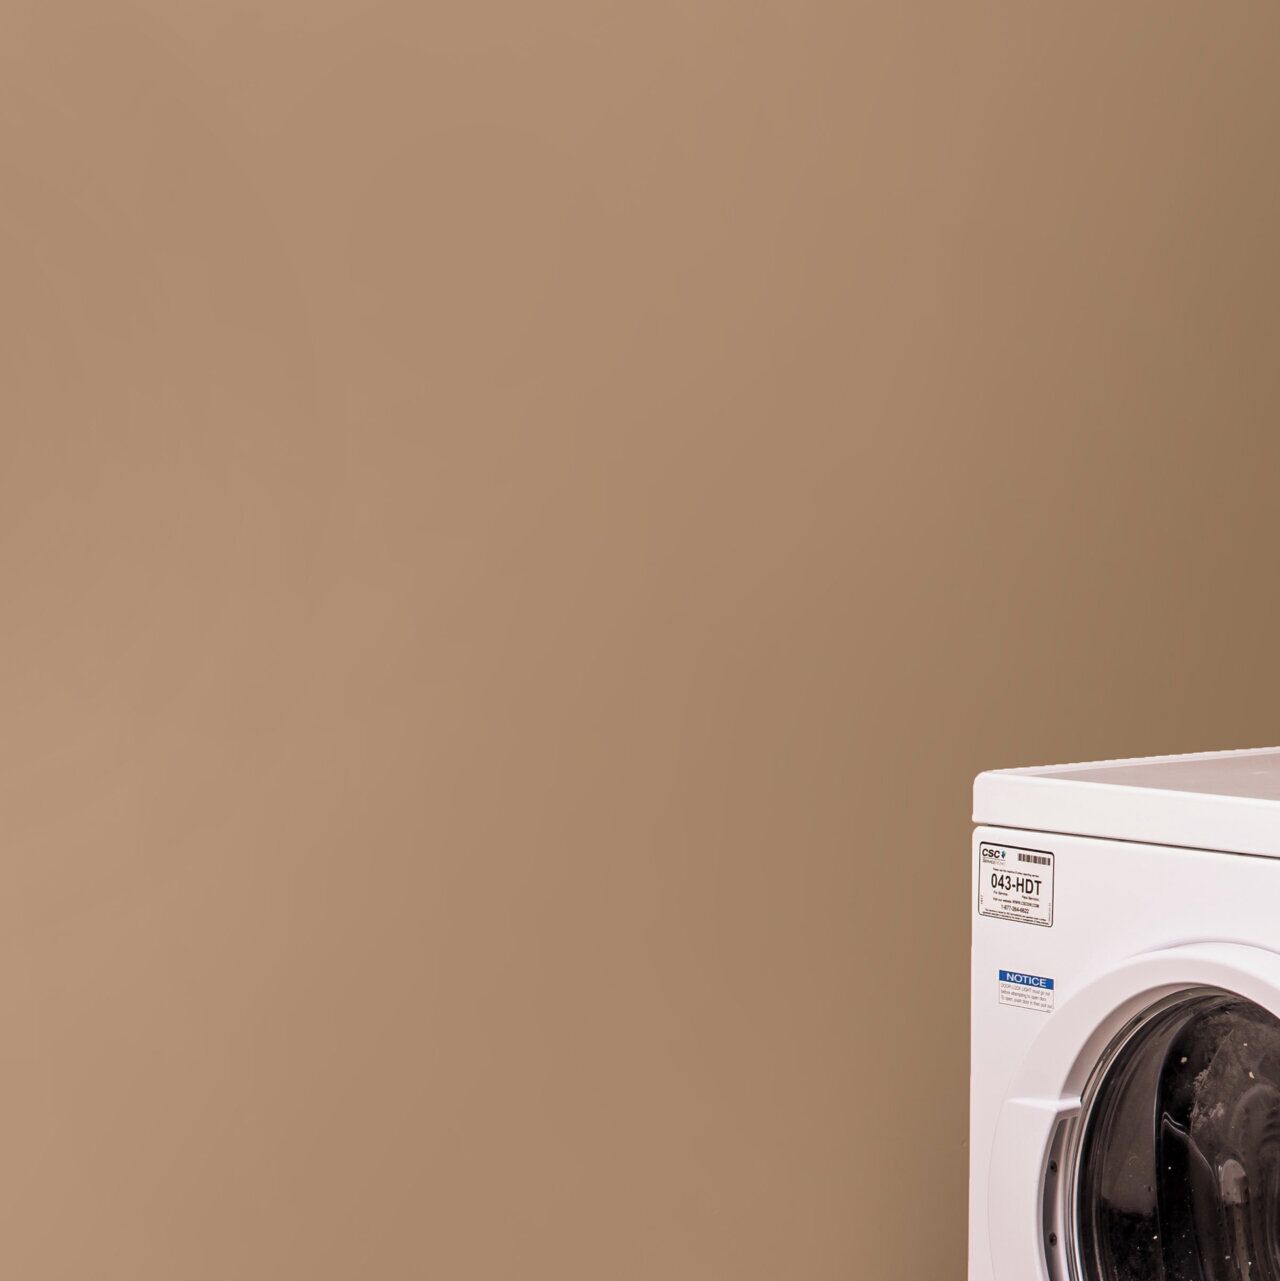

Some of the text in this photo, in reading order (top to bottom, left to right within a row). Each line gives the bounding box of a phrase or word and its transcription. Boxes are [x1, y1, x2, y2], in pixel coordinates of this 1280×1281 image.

[982, 849, 1000, 858] CSC
[991, 873, 1042, 895] 043-HDT
[1006, 973, 1047, 987] NOTICE
